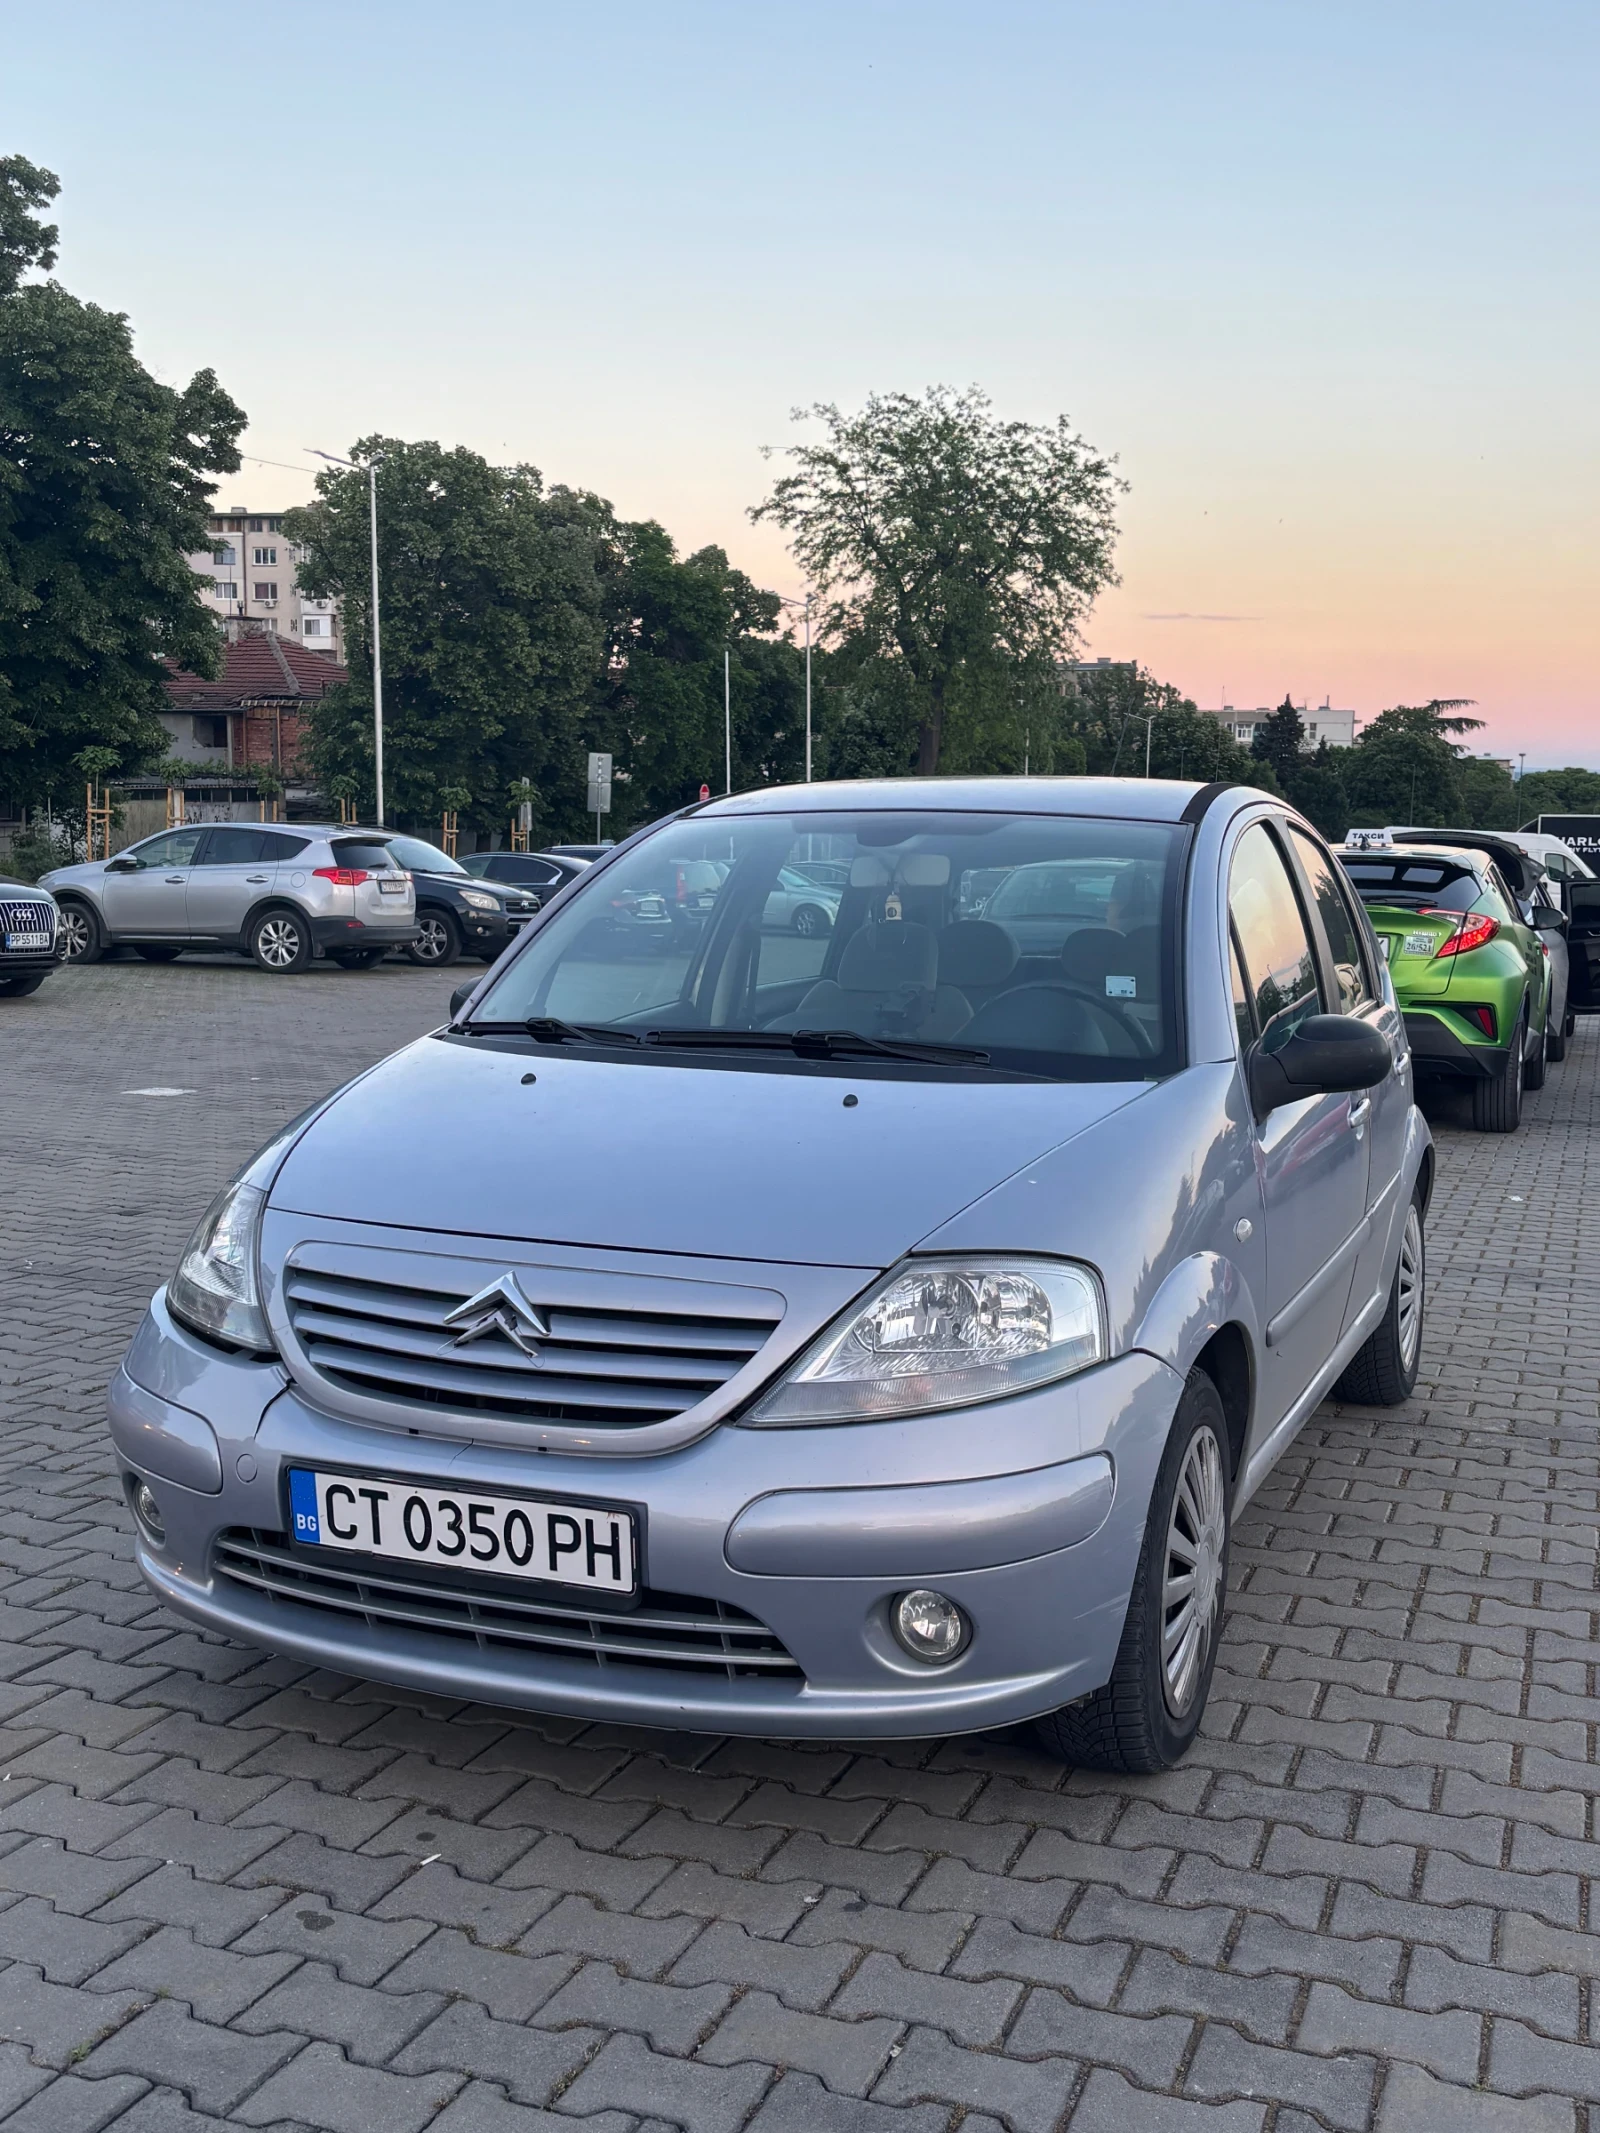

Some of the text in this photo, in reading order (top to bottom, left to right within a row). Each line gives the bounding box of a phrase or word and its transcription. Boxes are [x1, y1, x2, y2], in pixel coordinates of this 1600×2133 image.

[1557, 836, 1600, 846] ARL
[21, 934, 39, 945] 5511
[296, 1513, 317, 1532] BG
[325, 1484, 622, 1581] CT 0350 PH
